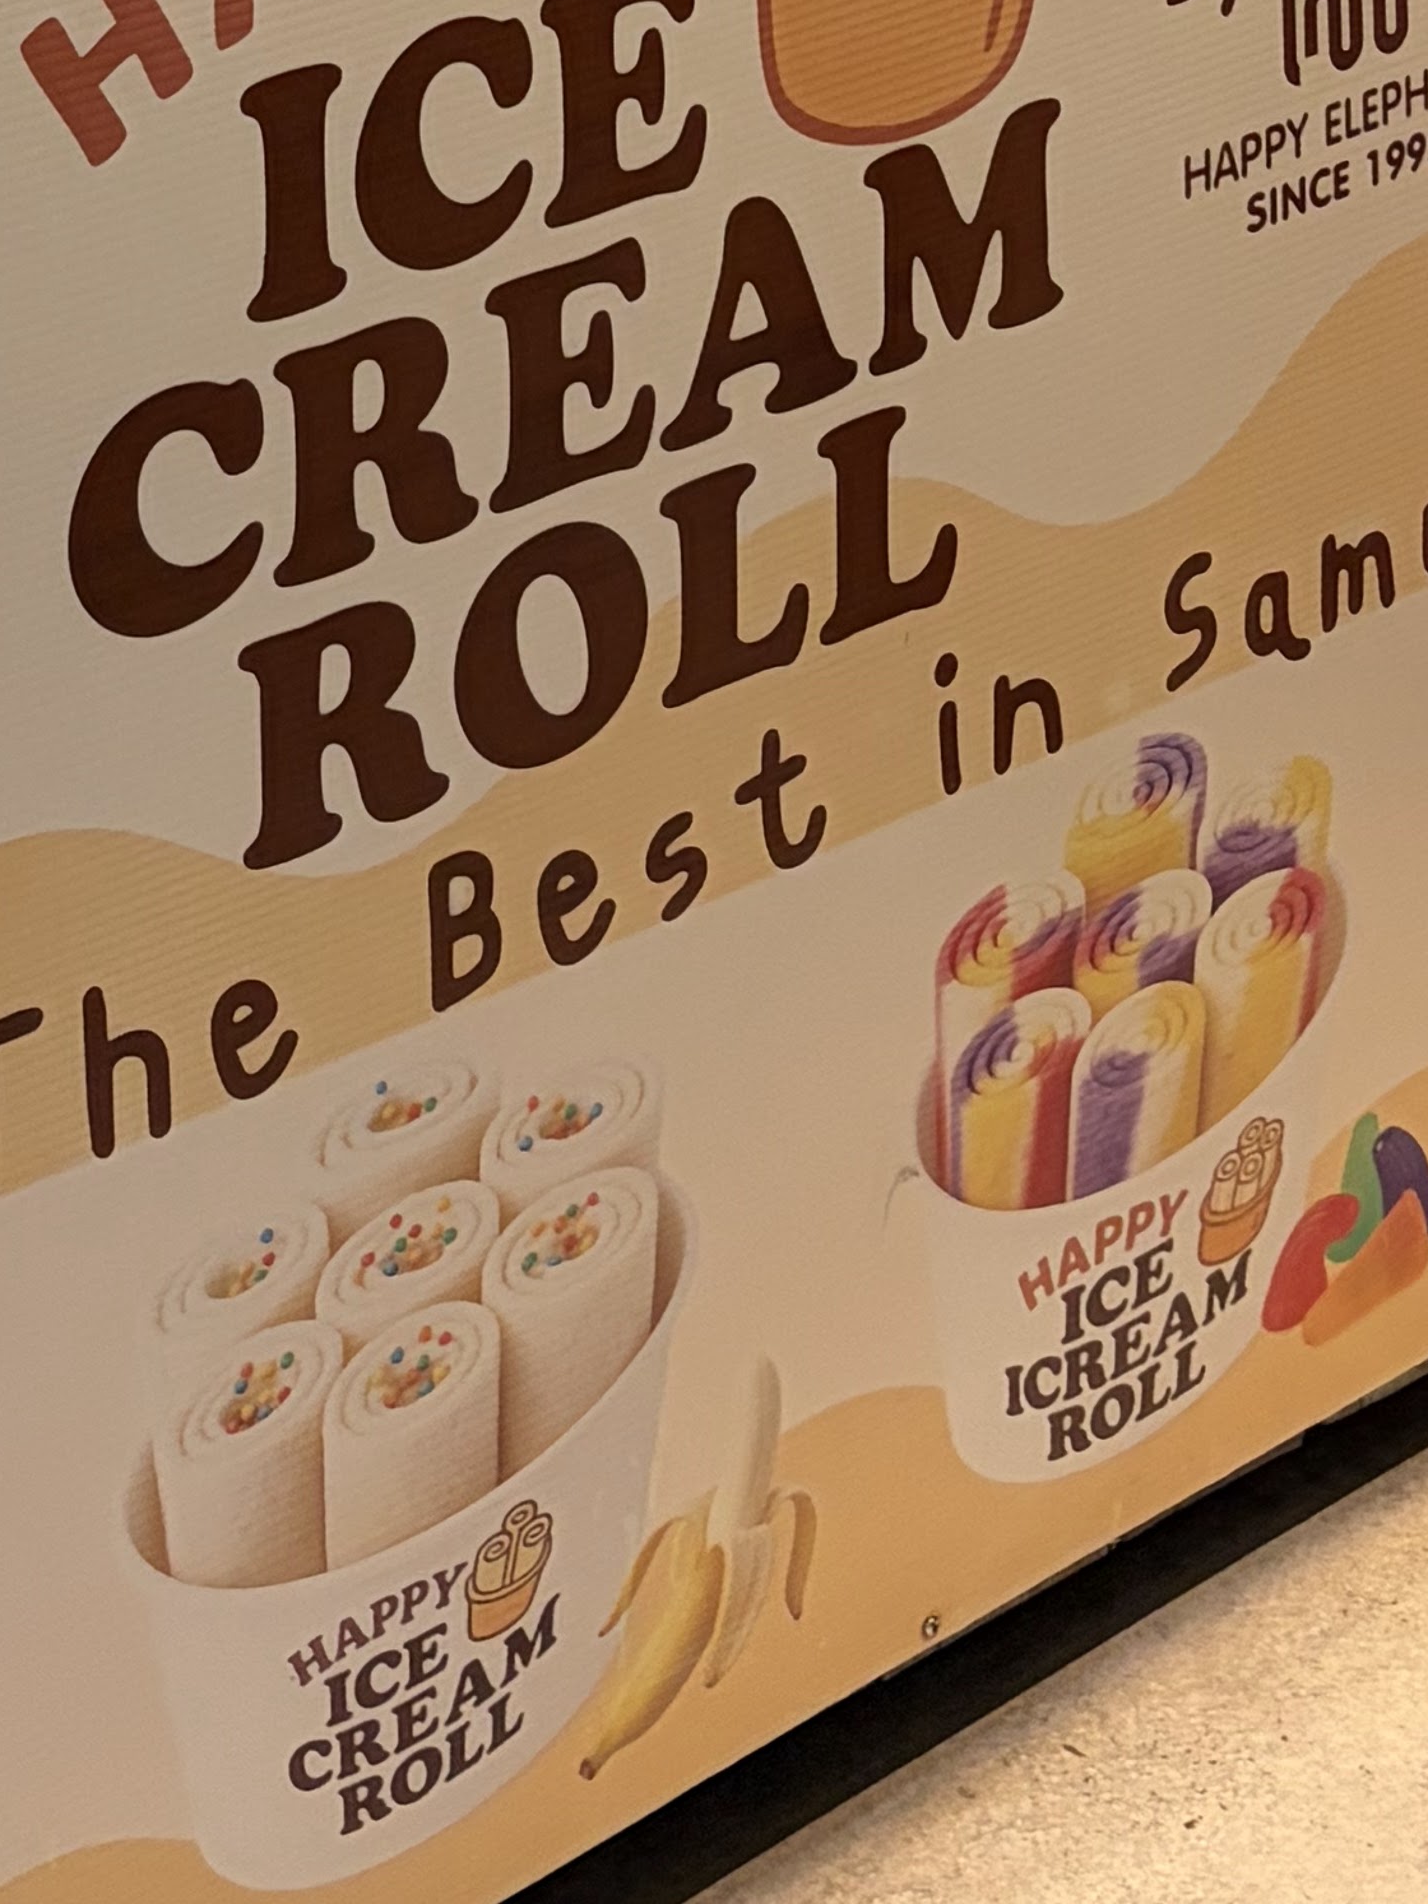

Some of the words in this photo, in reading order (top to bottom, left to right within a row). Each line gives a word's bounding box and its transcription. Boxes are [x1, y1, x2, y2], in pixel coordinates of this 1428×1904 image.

[1184, 112, 1309, 200] HAPPY
[1246, 160, 1350, 233] SINCE
[68, 98, 1064, 639] CREAM
[237, 405, 959, 871] ROLL
[427, 729, 828, 1012] Best
[936, 651, 1062, 796] in
[1018, 1189, 1189, 1311] HAPPY
[1061, 1237, 1174, 1344] ICE
[1005, 1248, 1253, 1416] ICREAM
[1047, 1341, 1206, 1461] ROLL
[287, 1561, 469, 1687] HAPPY
[324, 1622, 449, 1727] ICE
[288, 1592, 561, 1791] CREAM
[338, 1692, 525, 1835] ROLL
